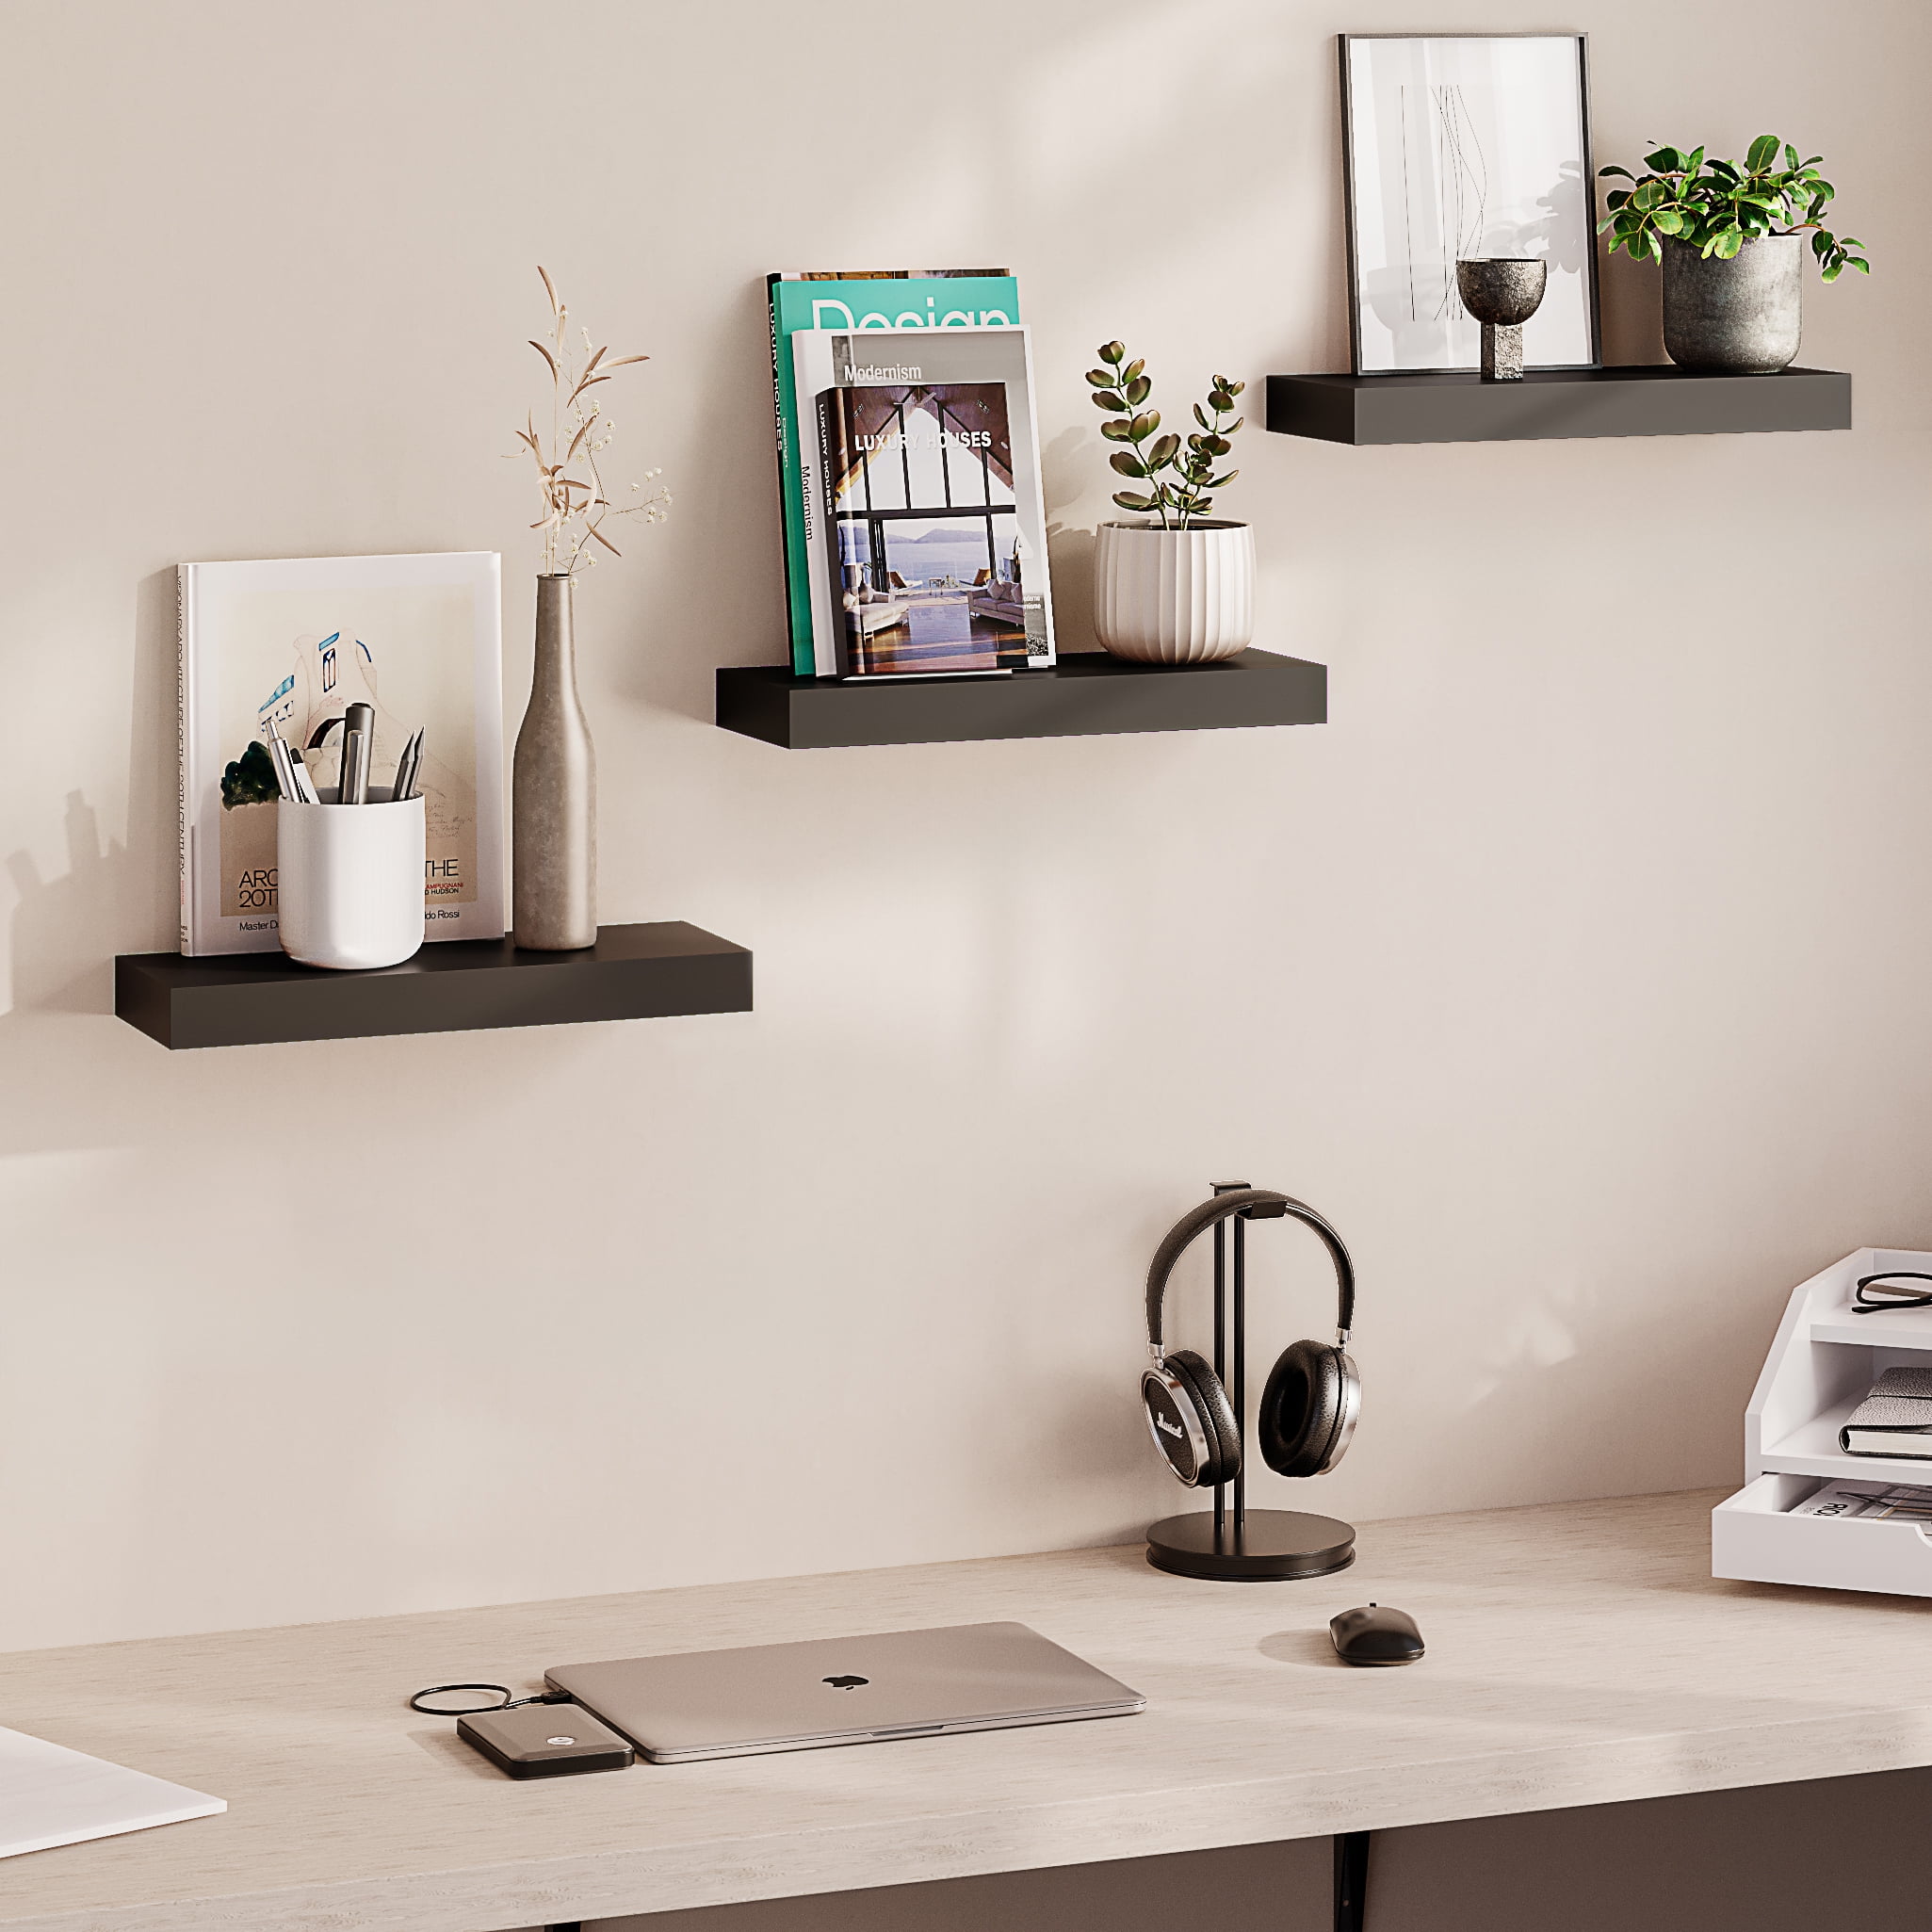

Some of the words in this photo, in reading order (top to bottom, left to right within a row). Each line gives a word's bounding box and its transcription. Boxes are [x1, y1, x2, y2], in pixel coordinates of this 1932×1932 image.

[844, 363, 922, 382] Modernism
[819, 403, 828, 456] LUXURY
[854, 432, 919, 451] LUXURY
[926, 430, 993, 450] HOUSES
[823, 460, 833, 516] HOUSES
[802, 465, 813, 541] Modernism
[425, 882, 464, 890] AMPUGNANI
[239, 888, 278, 908] 20T
[239, 921, 268, 932] Master
[437, 909, 461, 919] Rossi
